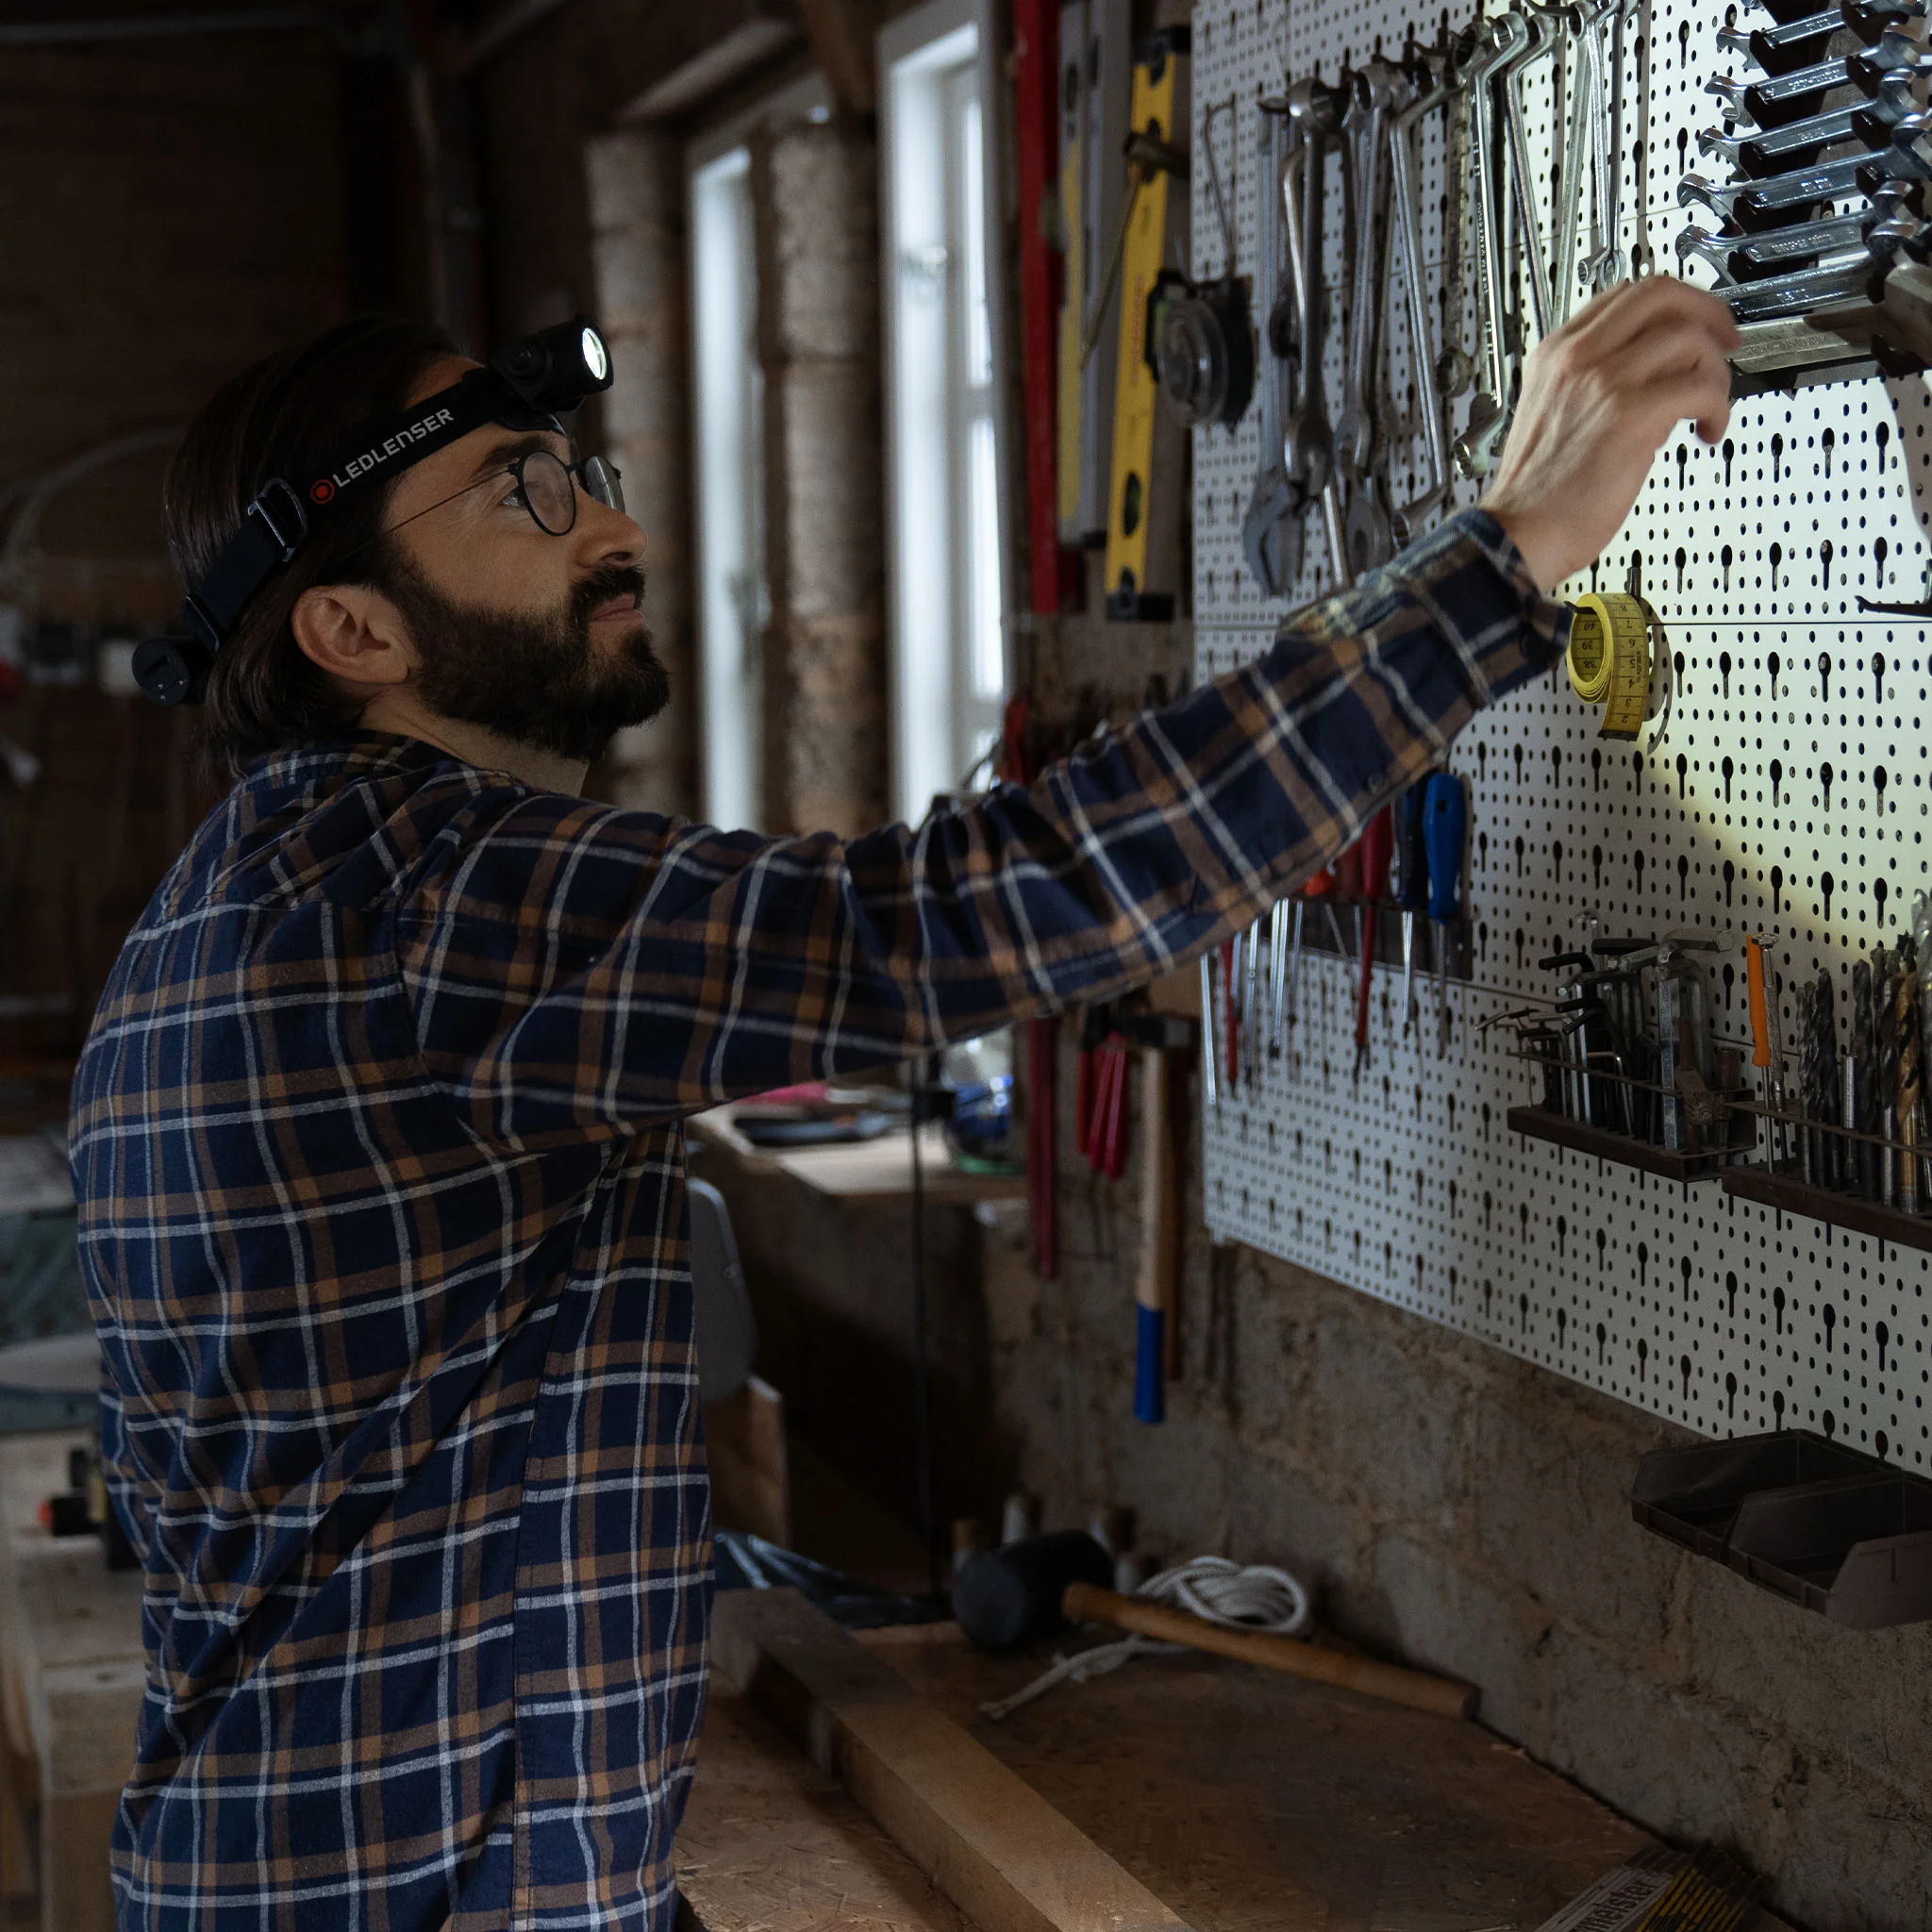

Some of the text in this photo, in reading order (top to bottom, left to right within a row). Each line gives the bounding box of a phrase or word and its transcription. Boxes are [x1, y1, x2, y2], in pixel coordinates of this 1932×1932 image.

[333, 408, 455, 488] LEDLENSER
[1582, 641, 1593, 650] 39
[1629, 638, 1635, 648] 6
[1630, 658, 1635, 669] 5
[1629, 679, 1635, 689] 4
[1625, 698, 1632, 708] 3
[1622, 714, 1629, 724] 2
